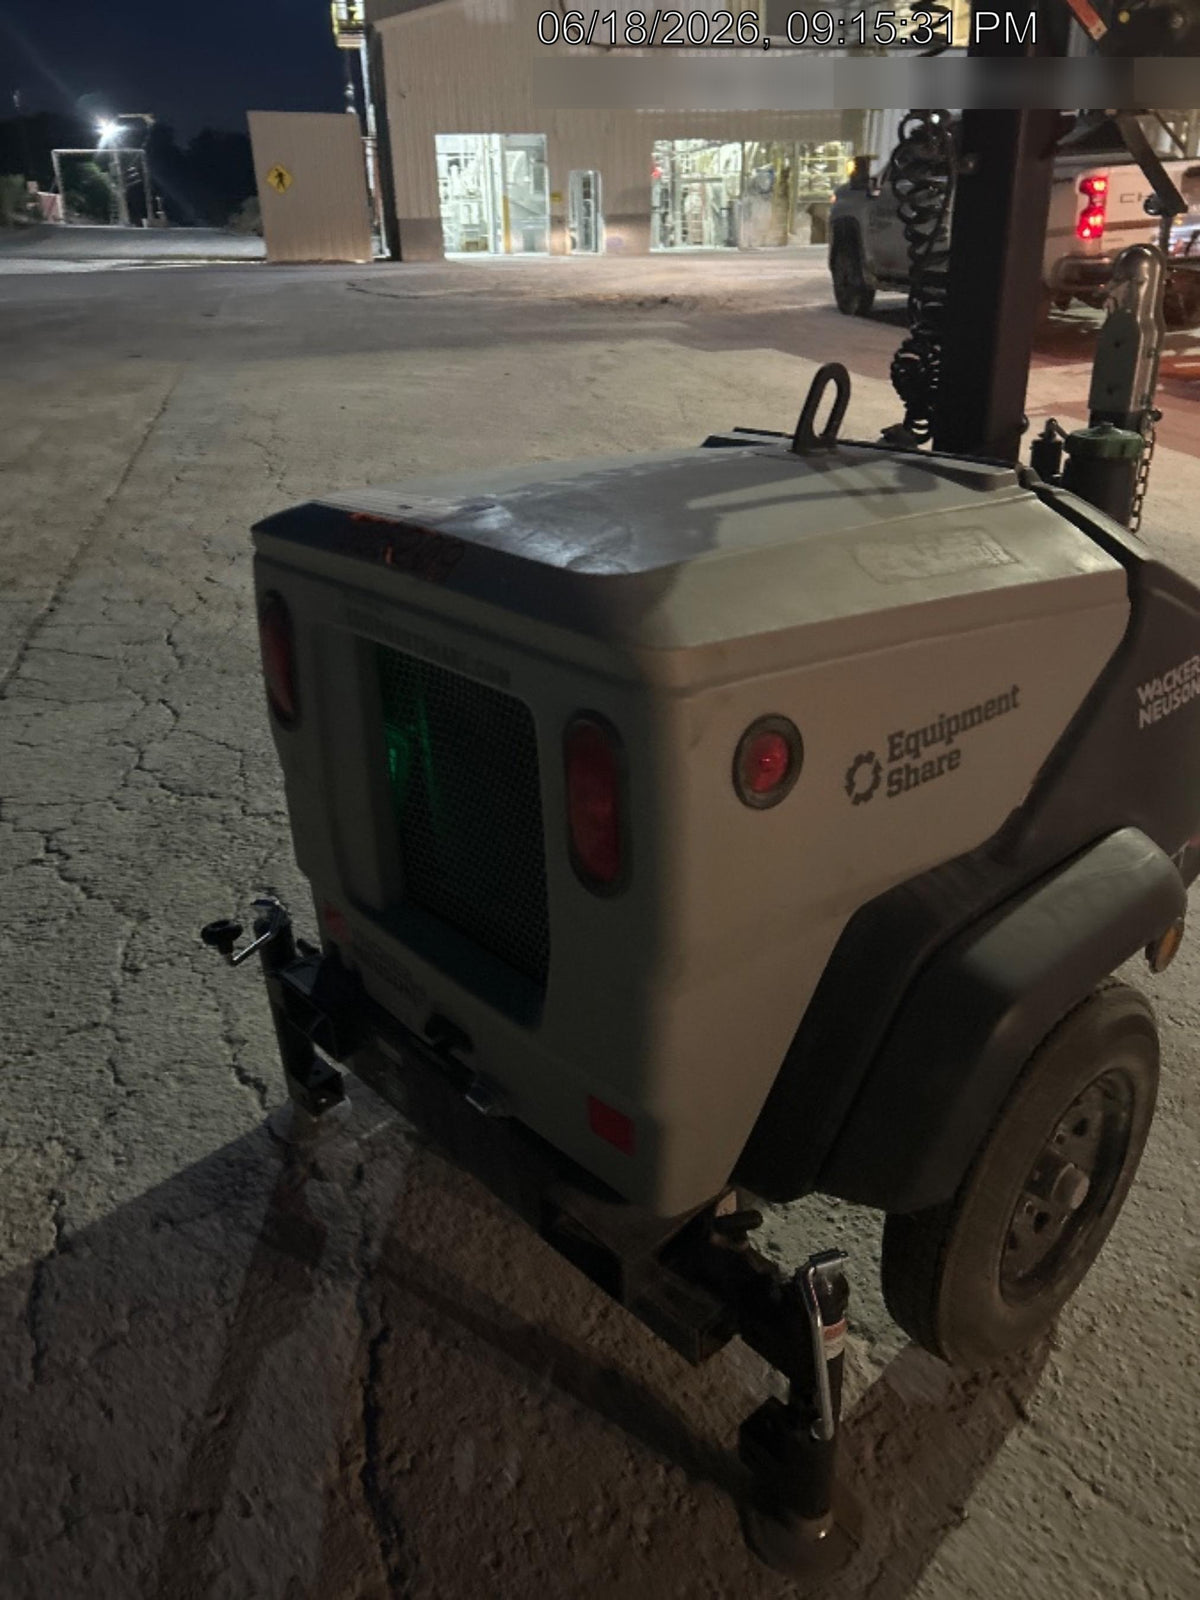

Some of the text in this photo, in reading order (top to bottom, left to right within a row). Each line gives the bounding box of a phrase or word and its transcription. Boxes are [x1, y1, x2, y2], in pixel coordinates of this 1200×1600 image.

[1136, 655, 1200, 706] WACKER
[1138, 678, 1200, 729] NEUSON
[886, 684, 1022, 762] Equipment
[886, 748, 962, 799] Share
